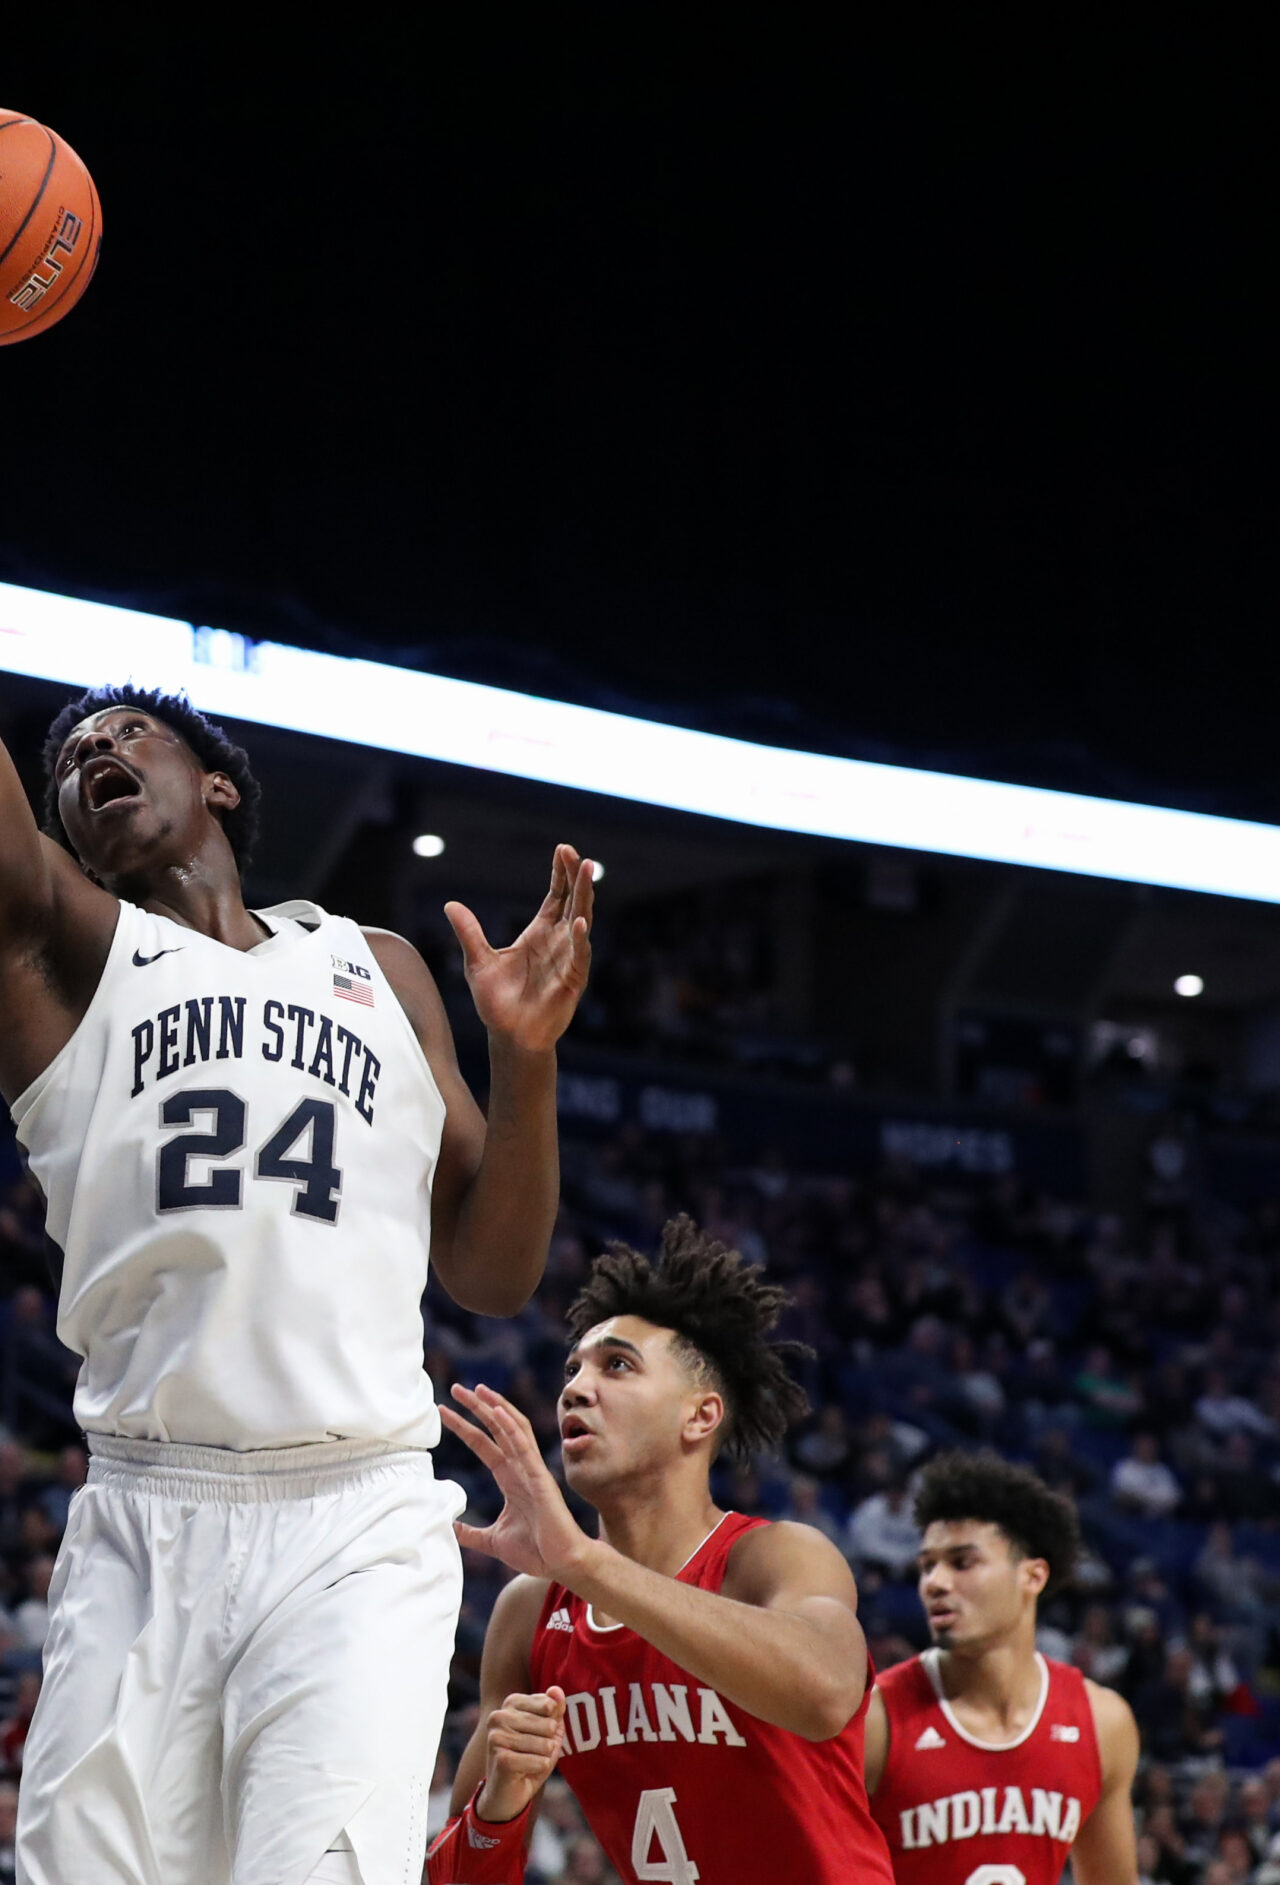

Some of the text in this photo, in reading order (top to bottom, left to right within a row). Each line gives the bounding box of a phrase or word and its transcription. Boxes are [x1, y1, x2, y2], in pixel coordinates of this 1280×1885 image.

[7, 206, 64, 298] CHAMPIONSHIP
[11, 210, 82, 311] ELITE
[131, 996, 381, 1127] PENN STATE
[156, 1087, 344, 1226] 24
[559, 1682, 747, 1758] DIANA
[632, 1787, 700, 1885] 4
[900, 1786, 1081, 1849] INDIANA
